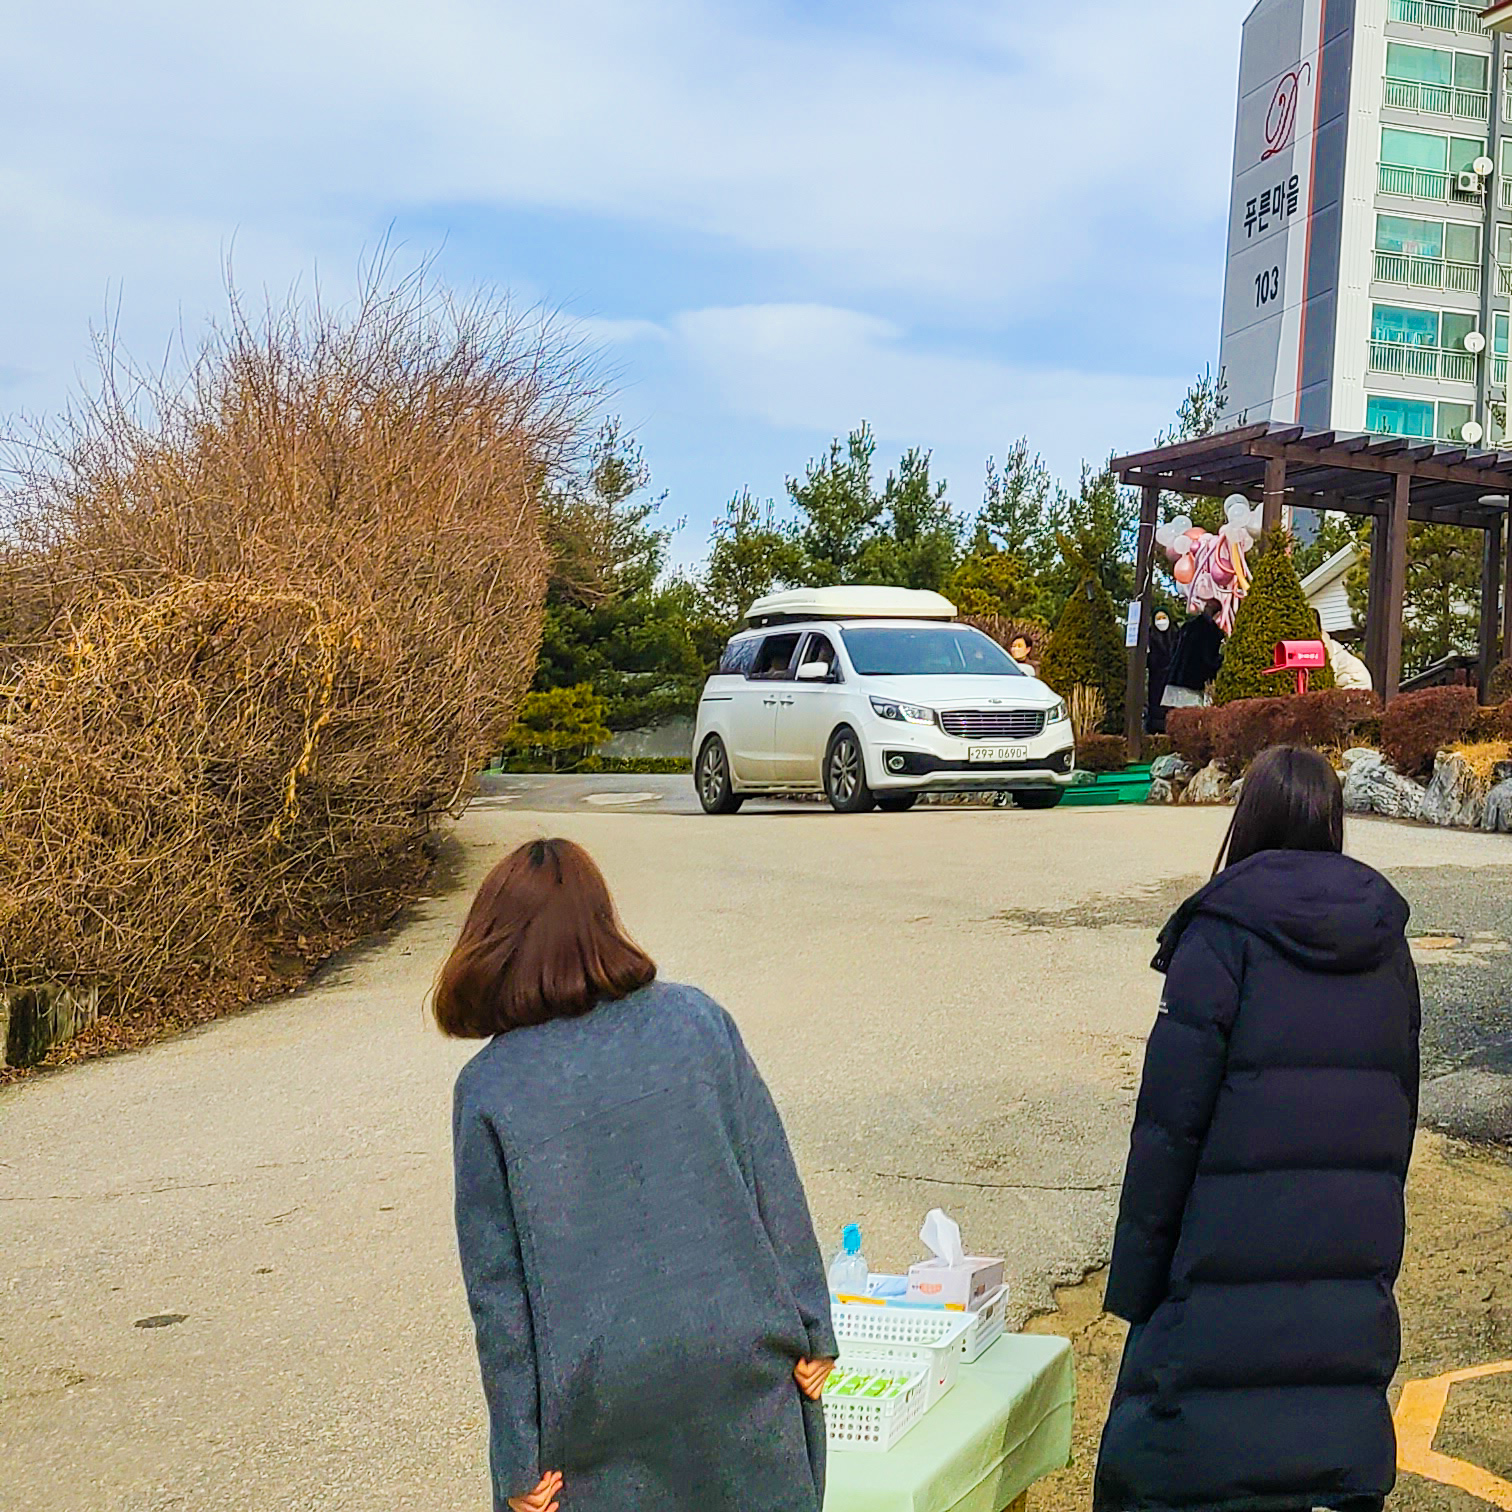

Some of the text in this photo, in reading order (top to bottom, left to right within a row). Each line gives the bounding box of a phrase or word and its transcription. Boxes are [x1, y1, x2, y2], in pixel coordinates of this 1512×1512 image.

[1243, 174, 1299, 238] 푸른마을
[1255, 266, 1279, 308] 103
[998, 748, 1022, 759] 0690
